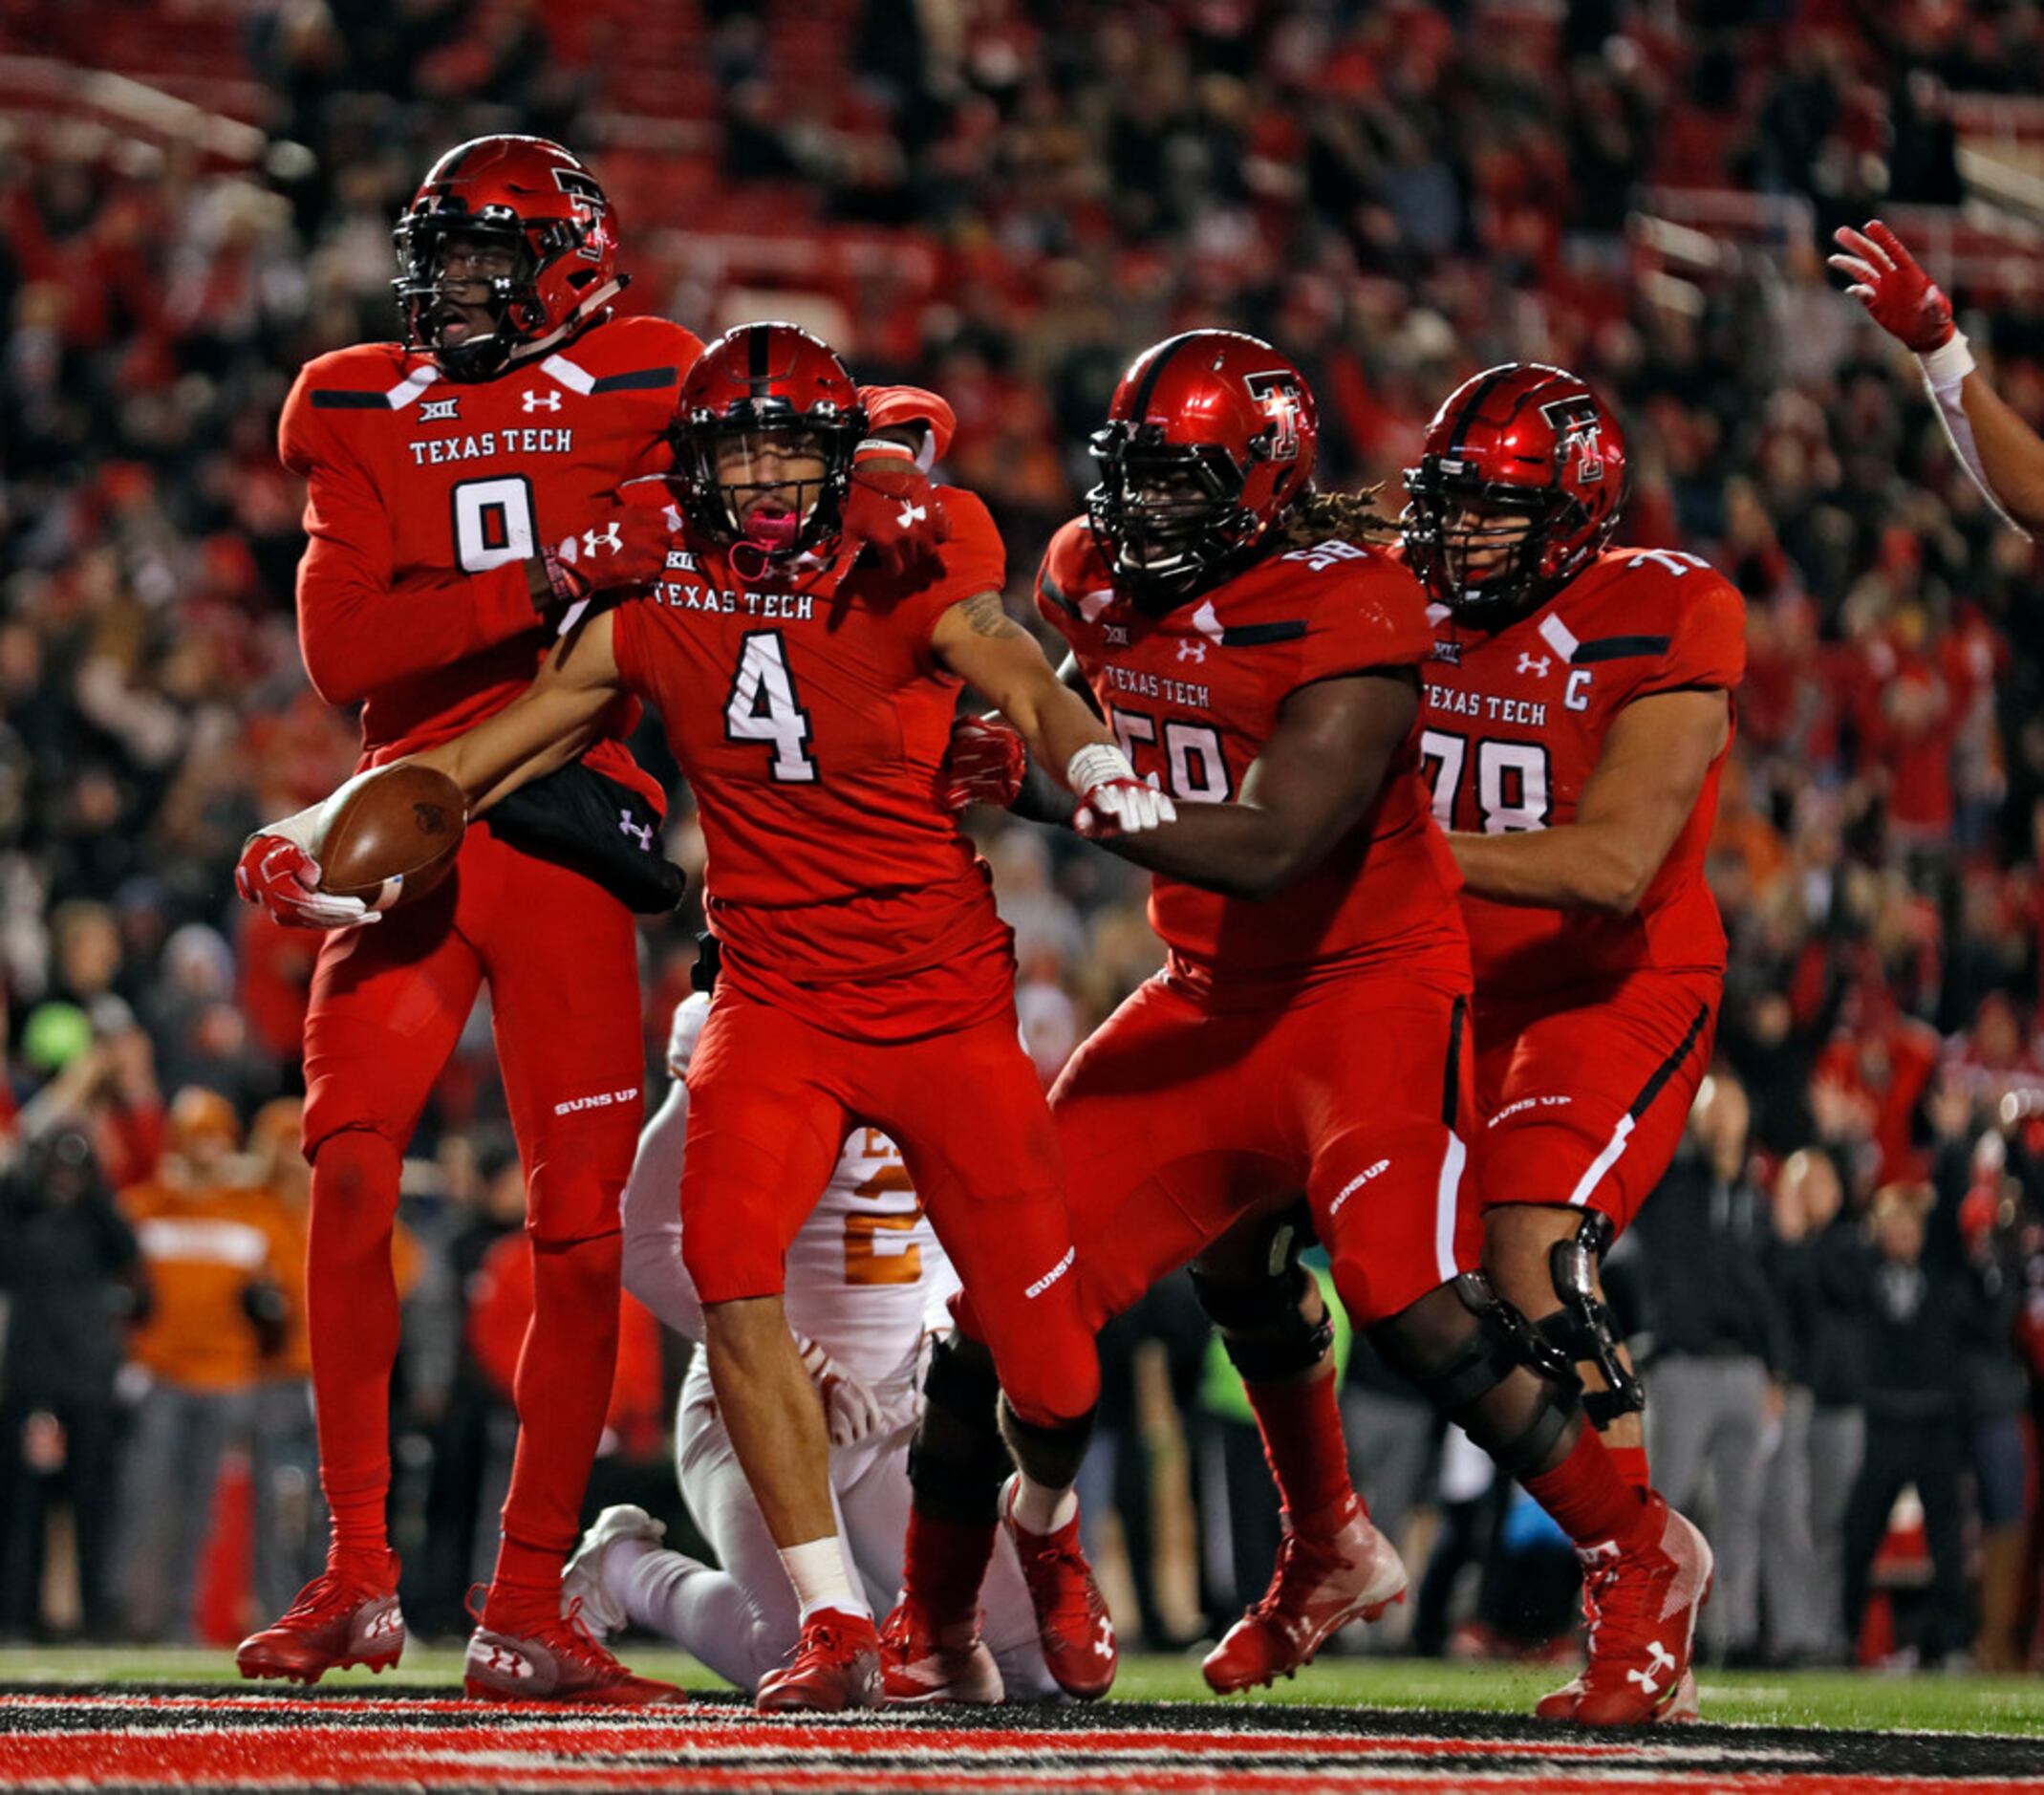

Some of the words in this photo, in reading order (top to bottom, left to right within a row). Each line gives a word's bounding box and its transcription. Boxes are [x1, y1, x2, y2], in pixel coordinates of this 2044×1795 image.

[409, 432, 495, 465] TEXAS
[502, 429, 572, 452] TECH
[1281, 539, 1368, 572] 58
[744, 593, 812, 619] TECH
[724, 629, 817, 782] 4
[1162, 679, 1209, 707] TECH
[1423, 683, 1481, 716] EXAS
[1486, 696, 1546, 726] TECH
[1564, 670, 1592, 711] C
[1420, 730, 1550, 834] 78
[554, 1092, 613, 1115] GUNS
[614, 1088, 637, 1103] UP
[1025, 1260, 1068, 1299] GUNS
